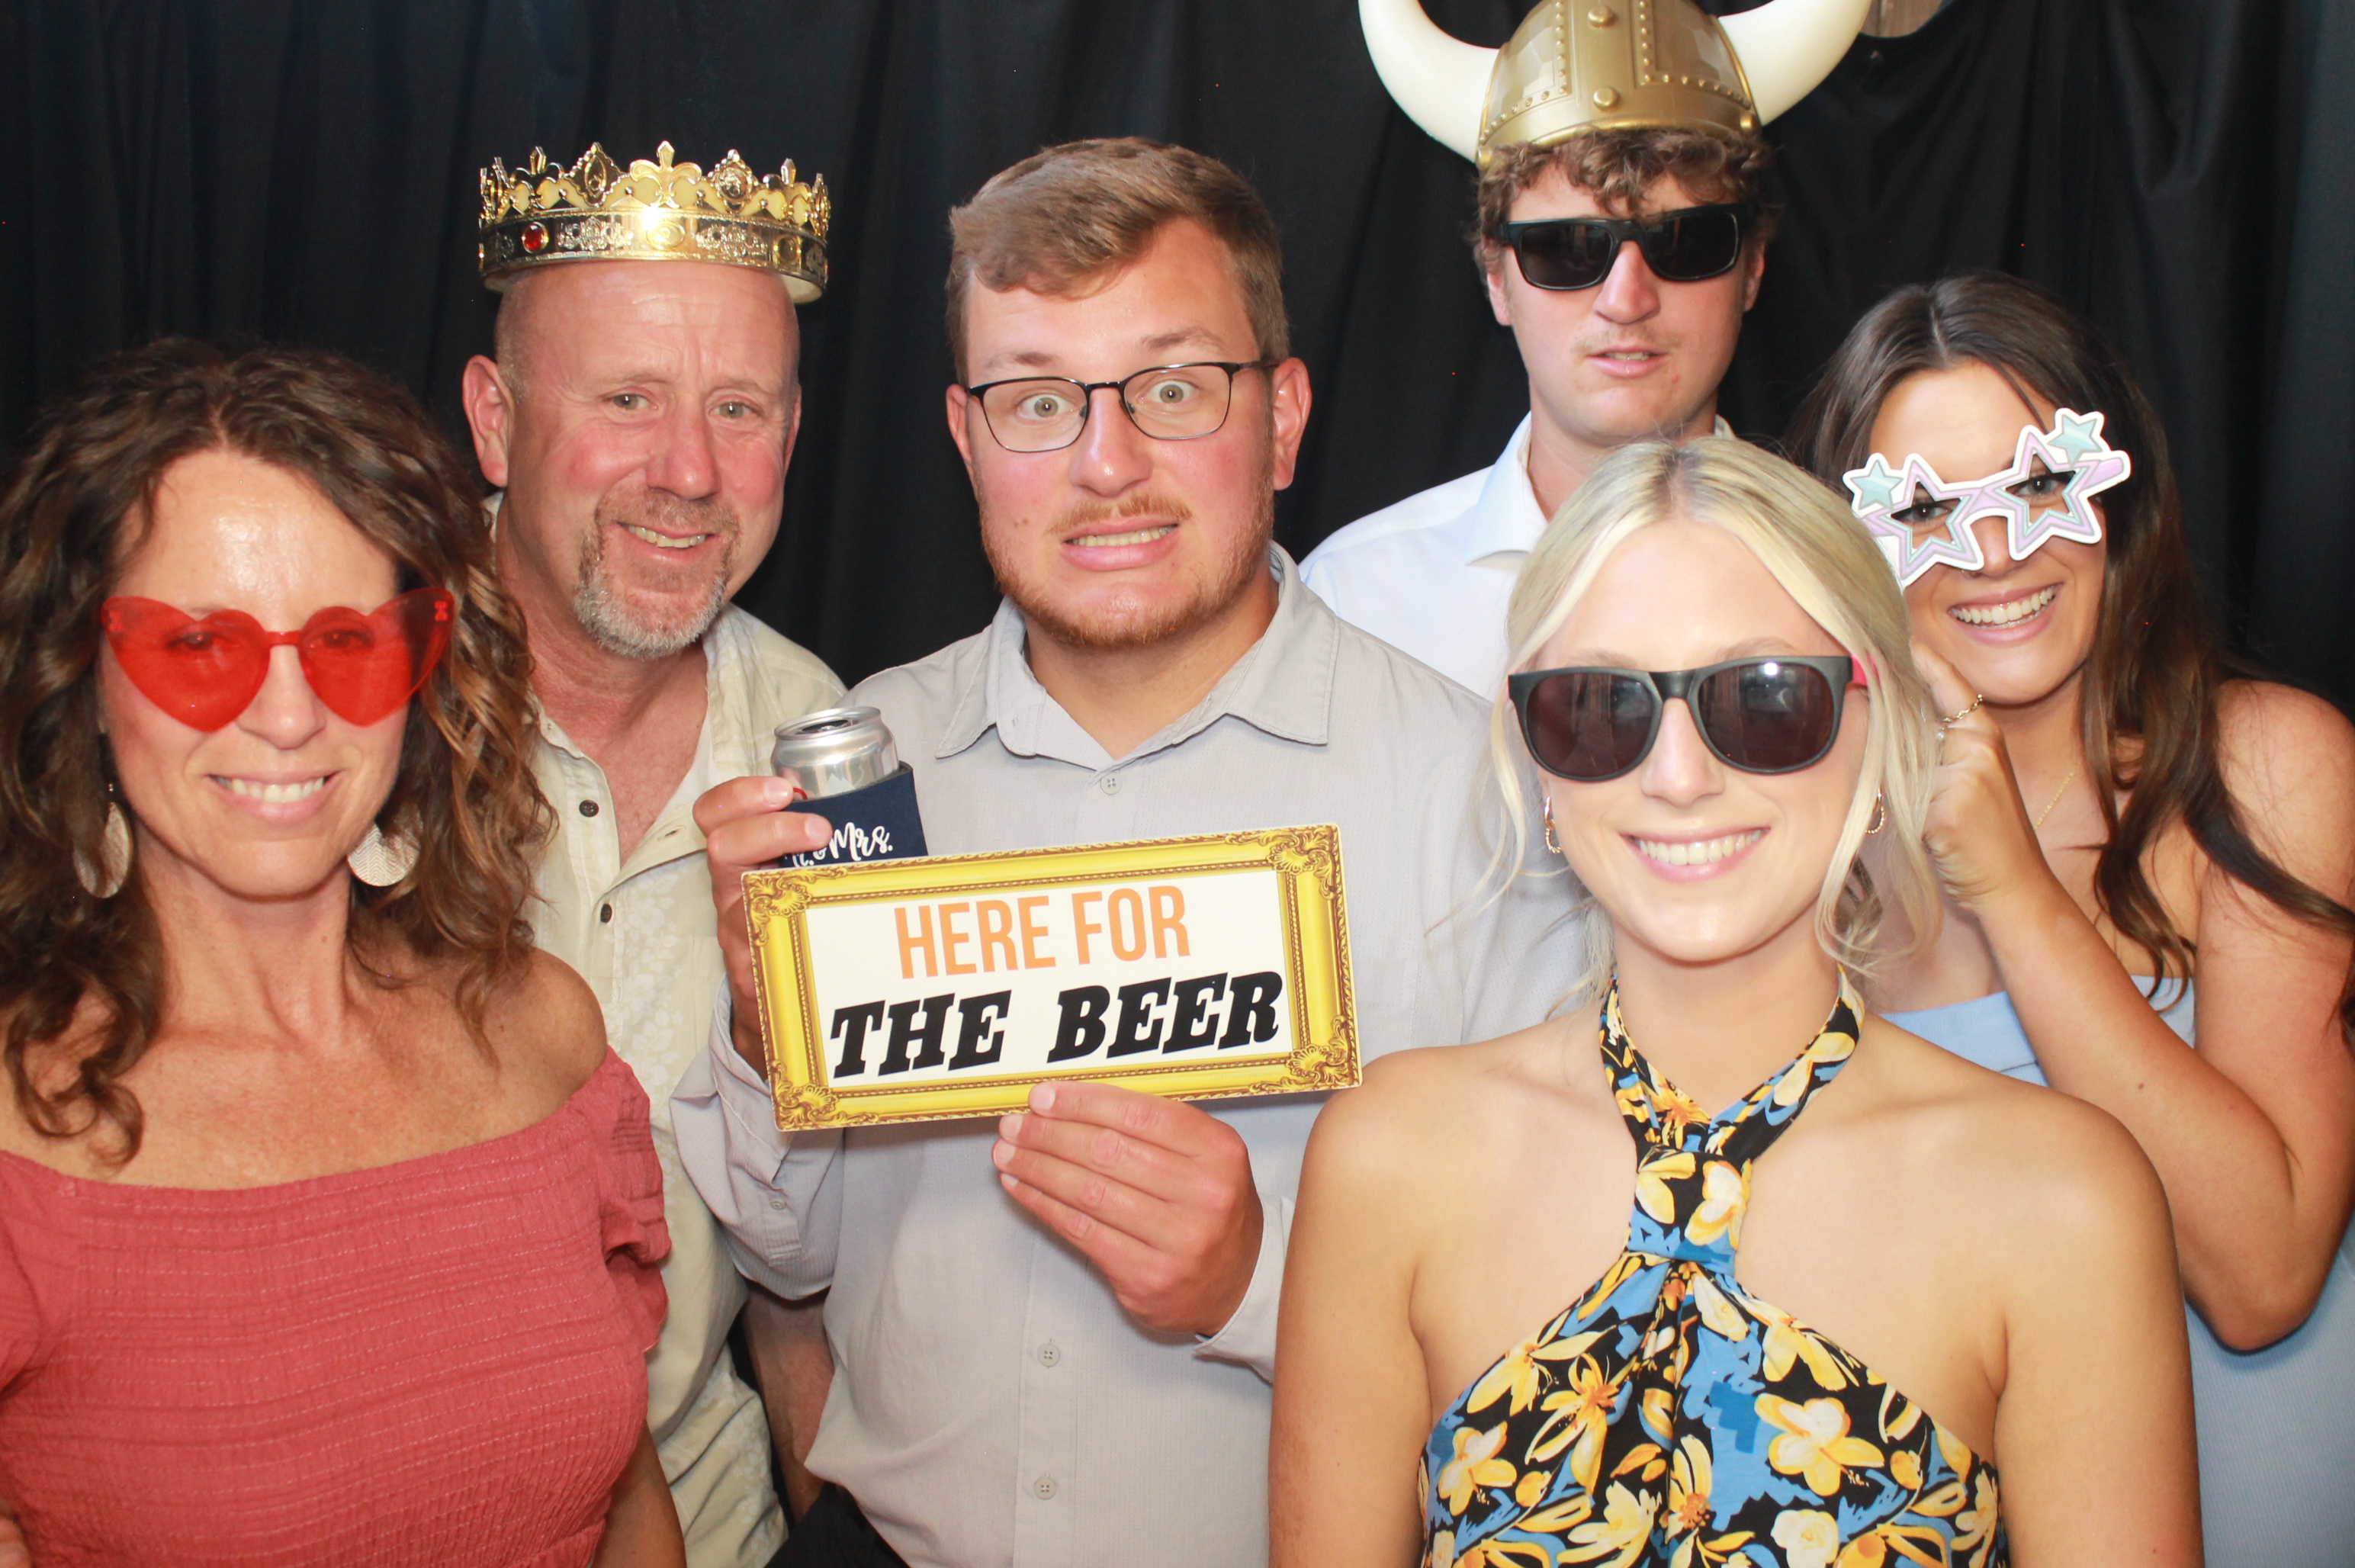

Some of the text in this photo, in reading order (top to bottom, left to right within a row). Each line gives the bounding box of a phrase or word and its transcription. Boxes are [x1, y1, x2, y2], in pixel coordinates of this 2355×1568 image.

[828, 821, 894, 862] Mrs.
[895, 885, 1190, 978] HERE FOR
[830, 972, 1283, 1078] THE BEER
